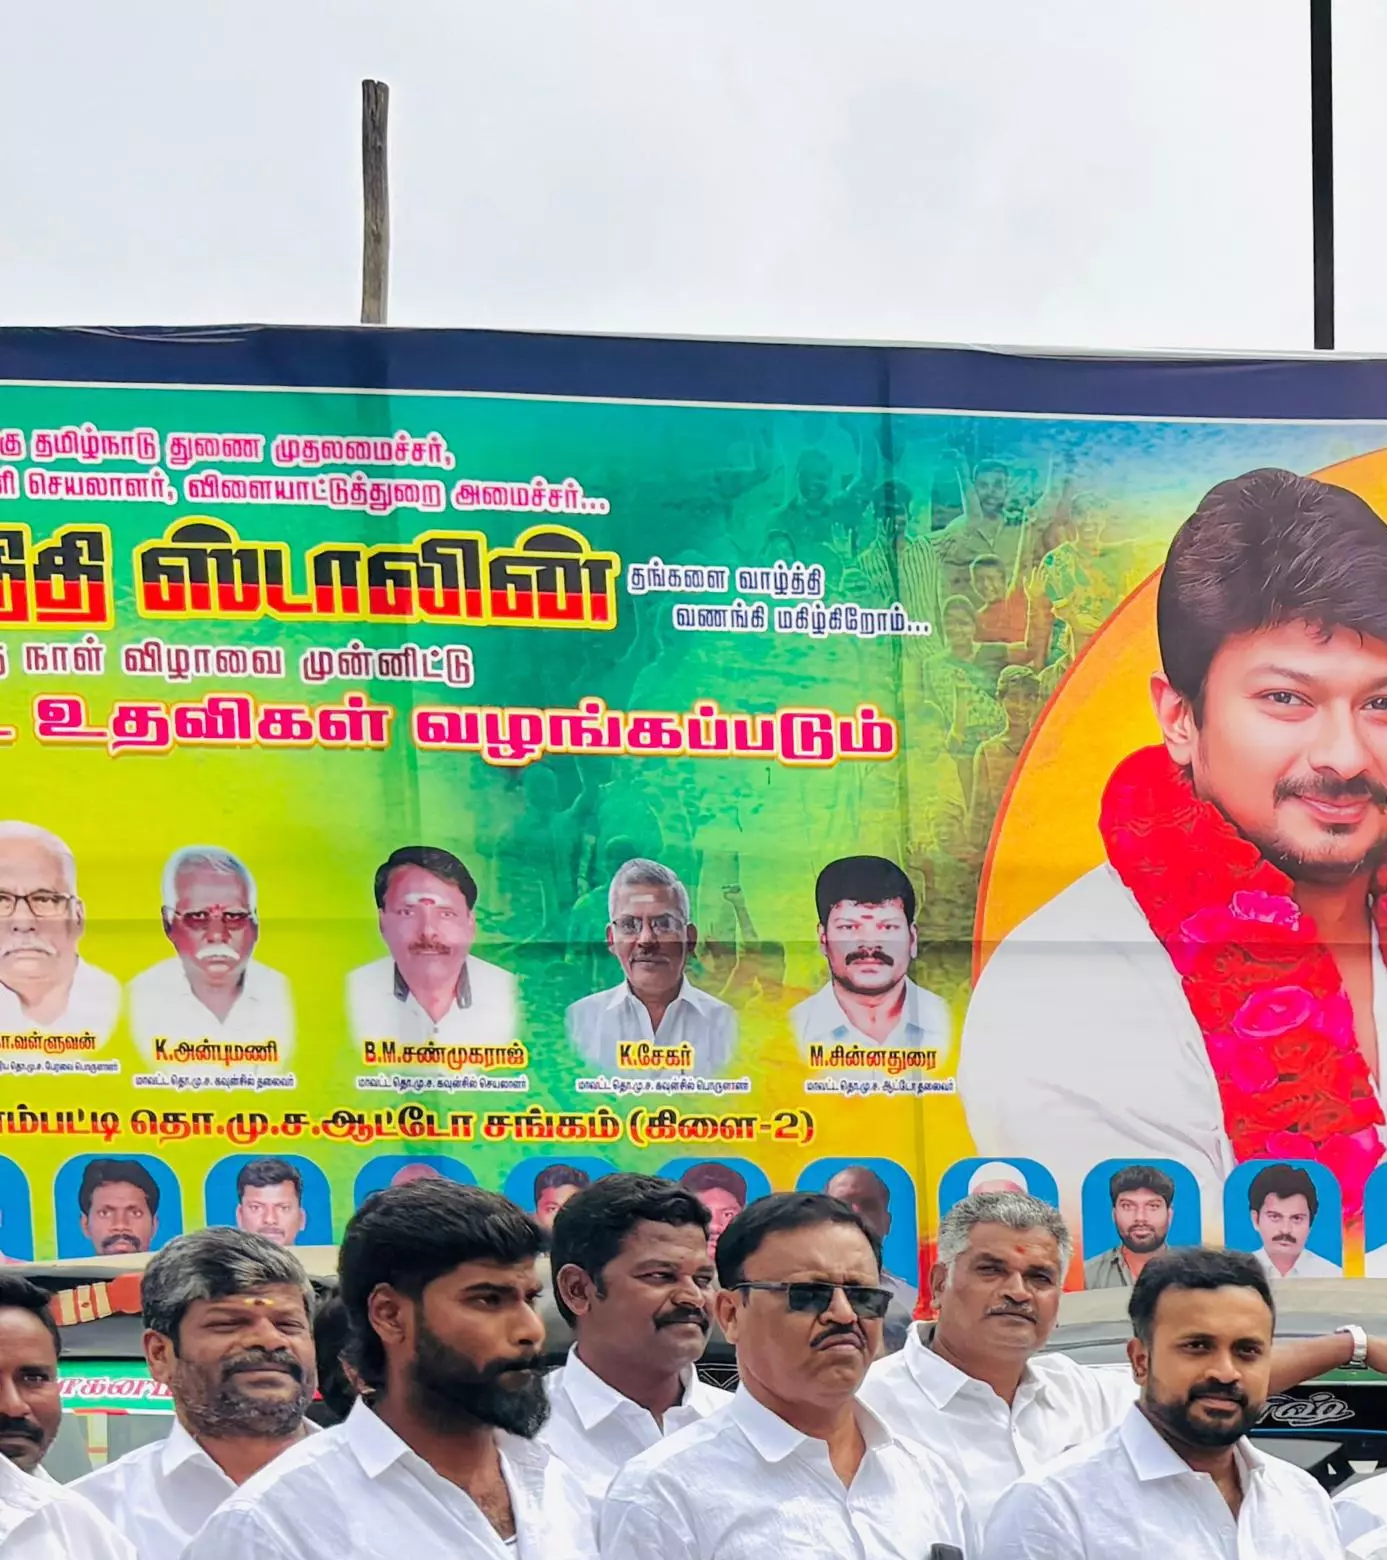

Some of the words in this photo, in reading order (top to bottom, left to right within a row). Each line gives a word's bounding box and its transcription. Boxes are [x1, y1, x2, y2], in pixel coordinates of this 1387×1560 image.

[35, 425, 157, 460] தமிழ்நாடு
[169, 435, 262, 464] துணை
[275, 434, 451, 466] முதலமைச்சர்,
[28, 471, 175, 501] செயலாளர்,
[188, 472, 443, 511] விளையாட்டுத்துறை
[455, 478, 607, 511] அமைச்சர்...
[140, 522, 613, 623] ஸ்டாலின்
[631, 561, 726, 591] தங்களை
[740, 563, 822, 595] வாழ்த்தி
[676, 601, 766, 629] வணங்கி
[778, 602, 929, 635] மகிழ்கிறோம்...
[25, 636, 104, 673] நாள்
[124, 641, 282, 680] விழாவை
[303, 642, 471, 684] முன்னிட்டு
[37, 696, 390, 750] உதவிகள்
[416, 702, 894, 760] வழங்கப்படும்
[0, 1031, 97, 1054] ா.வள்ளுவன்
[155, 1038, 279, 1066] K.அன்புமணி
[364, 1041, 525, 1070] B.M.சண்முகராஜ்
[619, 1043, 692, 1067] K.சேகர்
[809, 1044, 937, 1074] M.சின்னதுரை
[483, 1107, 620, 1139] சங்கம்
[631, 1109, 815, 1143] (கிளை-2)
